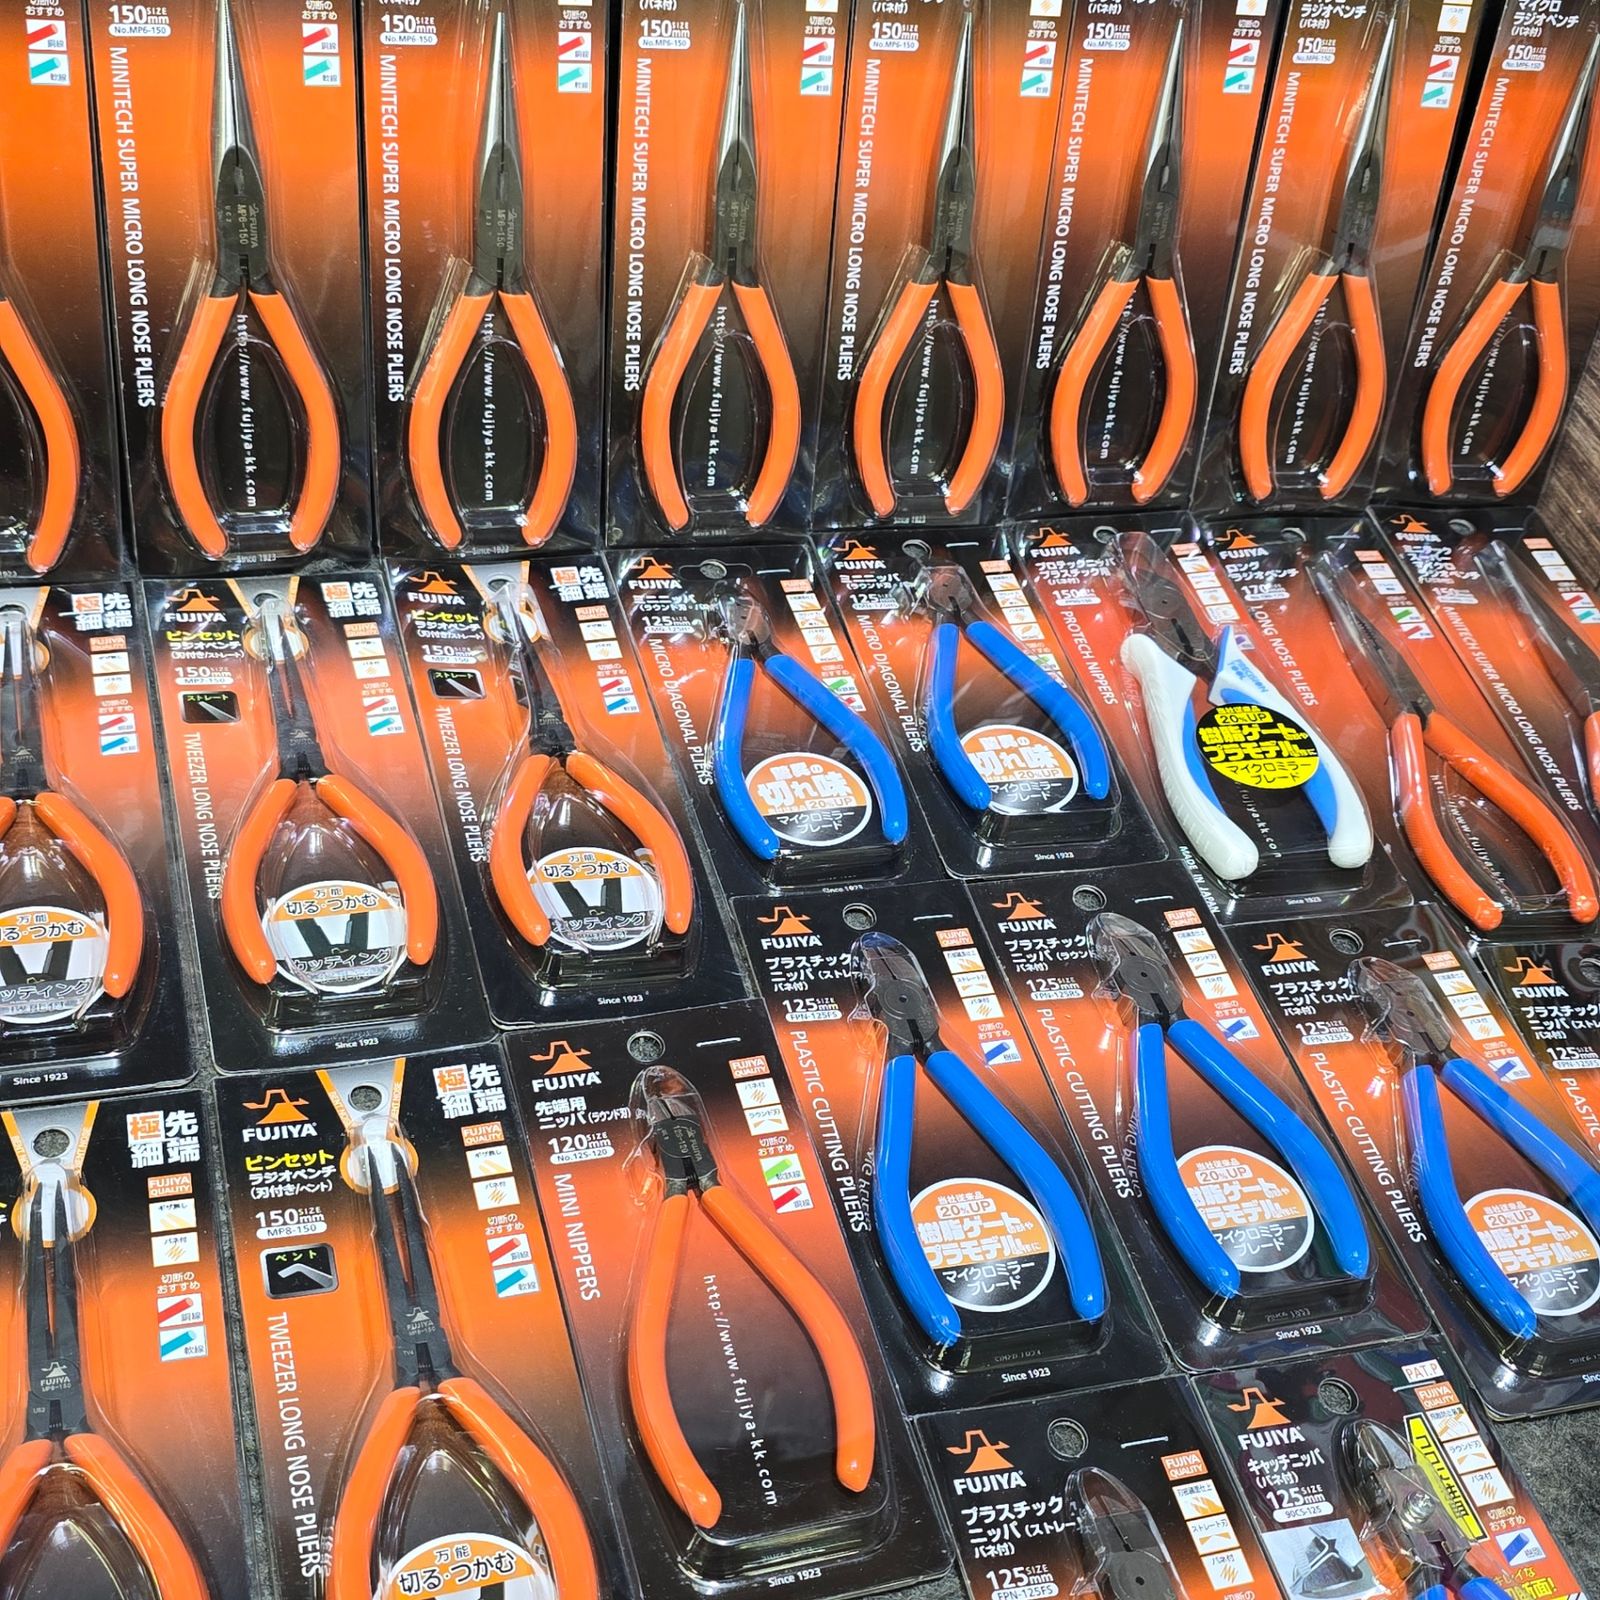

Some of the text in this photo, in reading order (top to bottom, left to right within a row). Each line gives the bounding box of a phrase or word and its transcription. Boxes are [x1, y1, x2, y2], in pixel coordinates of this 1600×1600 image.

[109, 47, 156, 407] MINITECH SUPER MICRO LONG NOSE PLIERS
[380, 55, 404, 402] MINITECH SUPER MICRO LONG NOSE PLIERS
[1414, 78, 1510, 368] MINITECH SUPER MICRO LONG NOSE PLIERS
[1030, 546, 1081, 558] FUJIYA
[1218, 548, 1269, 560] FUJIYA
[835, 560, 884, 570] FUJIYA
[628, 579, 680, 590] FUJIYA
[408, 593, 464, 605] FUJIYA
[164, 612, 226, 623] FUJIYA
[1060, 610, 1095, 659] PROTECH
[1087, 661, 1118, 705] NIPPERS
[1250, 605, 1278, 636] LONG
[1270, 637, 1296, 667] NOSE
[1288, 670, 1319, 706] PLIERS
[648, 639, 674, 676] MICRO
[663, 679, 698, 743] DIAGONAL
[856, 615, 926, 752] MICRO DIAGONAL PLIERS
[1443, 606, 1479, 651] MINITECH
[1472, 650, 1499, 680] SUPER
[1492, 683, 1521, 716] MICRO
[1514, 717, 1542, 744] LONG
[1534, 746, 1559, 774] NOSE
[1552, 777, 1583, 811] PLIERS
[967, 745, 1060, 776] 切れ味
[436, 705, 487, 862] TWEEZER LONG NOSE PLIERS
[757, 772, 852, 807] 切れ味
[184, 732, 222, 899] TWEEZER LONG NOSE PLIERS
[777, 811, 855, 824] マイクロミラー
[1178, 845, 1220, 913] MADE IN JAPAN
[998, 920, 1056, 933] FUJIYA
[761, 937, 821, 950] FUJIYA
[1010, 952, 1053, 963] ニッパ
[770, 968, 816, 982] ニッパ
[1261, 962, 1320, 976] FUJIYA
[598, 994, 643, 1005] Since 1923
[1278, 994, 1319, 1007] ニッパ
[1512, 986, 1568, 999] FUJIYA
[335, 1037, 379, 1049] Since 1923
[731, 1059, 765, 1070] FUJIYA
[734, 1067, 768, 1077] QUALITY
[13, 1072, 68, 1086] Since 1923
[531, 1073, 600, 1092] FUJIYA
[535, 1096, 587, 1117] 先端用
[1036, 1008, 1134, 1199] PLASTIC CUTTING PLIERS
[539, 1110, 587, 1130] ニッパ
[242, 1123, 316, 1142] FUJIYA
[463, 1125, 500, 1137] FUJIYA
[465, 1133, 502, 1145] QUALITY
[790, 1031, 868, 1233] PLASTIC CUTTING PLIERS
[1309, 1052, 1428, 1243] PLASTIC CUTTING PLIERS
[245, 1149, 334, 1171] ピンセット
[149, 1177, 190, 1187] FUJIYA
[249, 1165, 336, 1185] ラジオペンチ
[150, 1185, 191, 1196] QUALITY
[267, 1224, 317, 1237] MP8-150
[485, 1222, 525, 1235] おすすめ
[554, 1173, 600, 1301] MINI NIPPERS
[276, 1250, 317, 1261] ベント
[1238, 1239, 1285, 1256] ブレード
[942, 1261, 1035, 1283] マイクロミラー
[157, 1282, 200, 1295] おすすめ
[967, 1276, 1021, 1296] ブレード
[1530, 1283, 1578, 1300] ブレード
[1275, 1325, 1322, 1340] Since 1923
[1001, 1367, 1051, 1383] Since 1923
[1405, 1362, 1439, 1380] PAT.P
[703, 1274, 778, 1506] http://www.fujiya-kk.com
[1418, 1386, 1450, 1401] FUJIYA
[1423, 1395, 1455, 1408] QUALITY
[267, 1312, 321, 1577] TWEEZER LONG NOSE PLIERS
[1238, 1429, 1304, 1450] FUJIYA
[1165, 1455, 1200, 1468] FUJIYA
[1247, 1448, 1325, 1476] キャッチニッパ
[1169, 1464, 1204, 1478] QUALITY
[953, 1474, 1026, 1496] FUJIYA
[1256, 1471, 1299, 1489] (バネ付)
[1487, 1505, 1516, 1521] 切断の
[1489, 1516, 1526, 1531] おすすめ
[968, 1522, 1021, 1544] ニッパ
[768, 1568, 822, 1587] Since 1923
